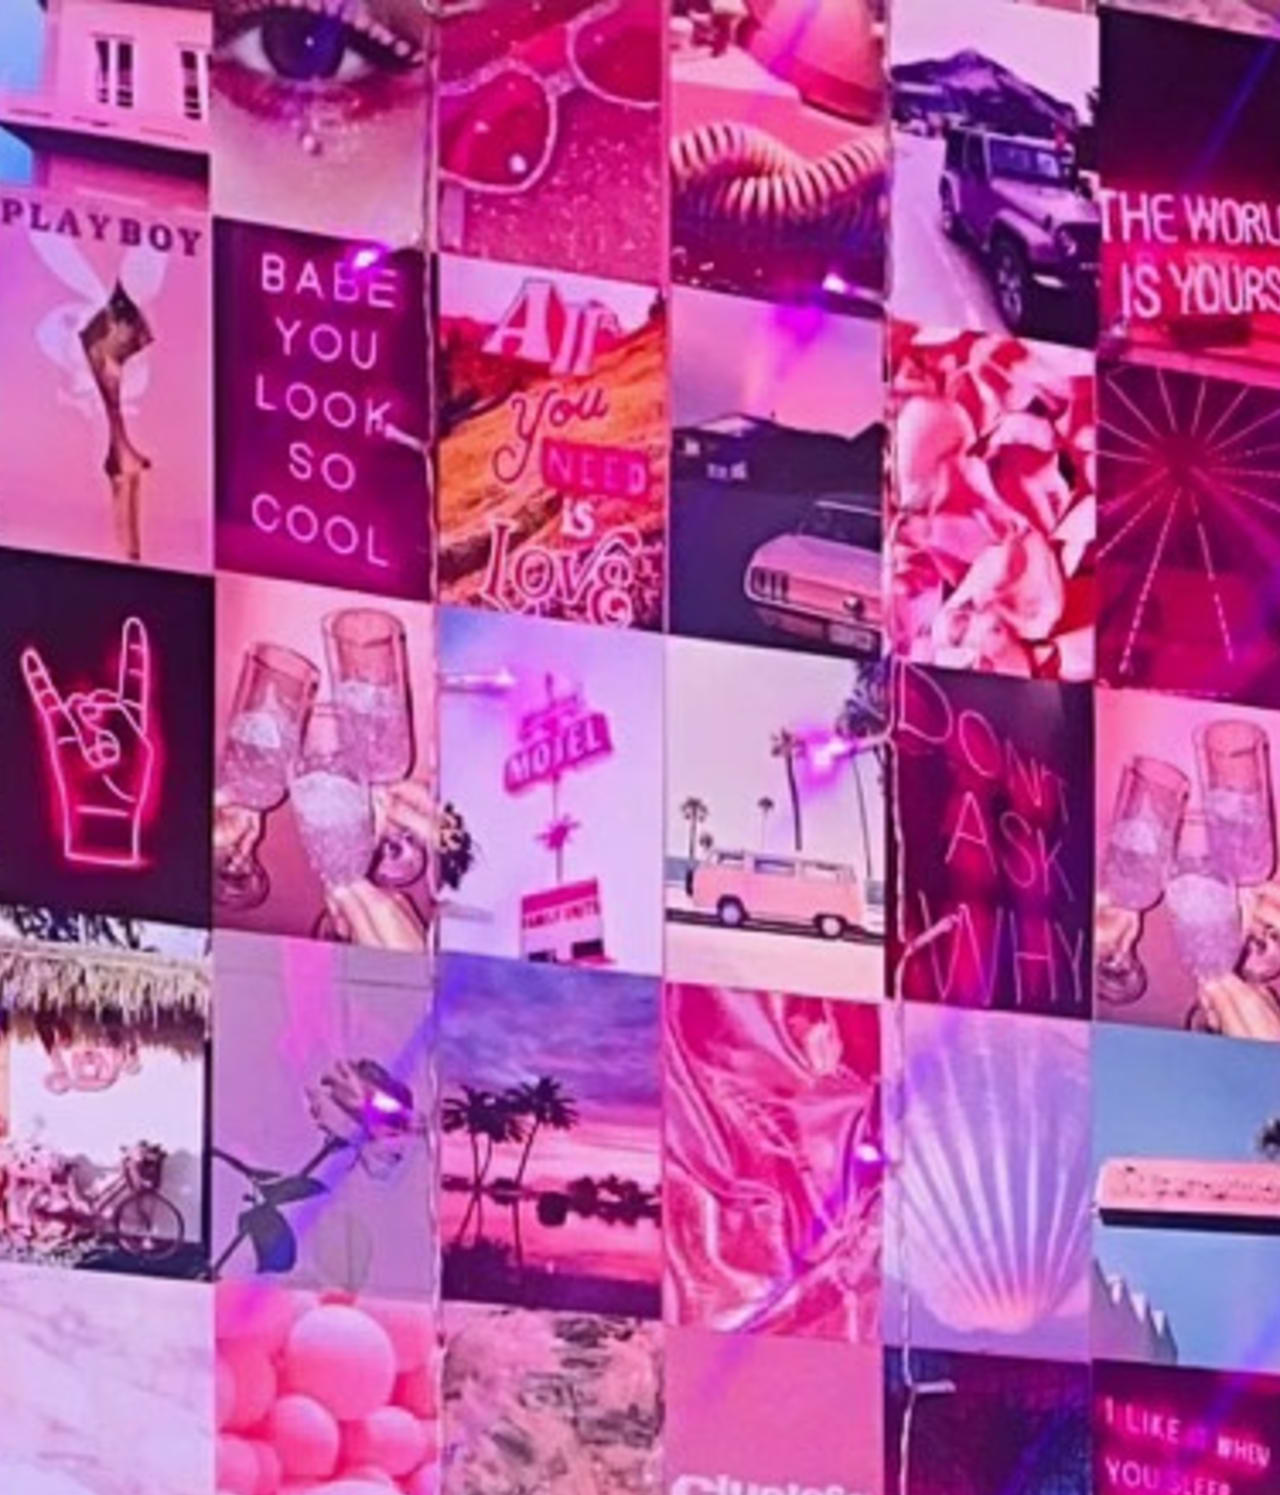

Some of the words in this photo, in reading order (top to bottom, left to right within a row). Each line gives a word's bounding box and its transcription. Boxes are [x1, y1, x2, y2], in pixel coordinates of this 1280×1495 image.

[0, 198, 203, 258] PLAYBOY
[1099, 189, 1176, 243] THE
[260, 251, 399, 309] BABE
[1121, 262, 1160, 317] IS
[275, 316, 379, 372] YOU
[255, 374, 388, 437] LOOK
[287, 441, 357, 491] SO
[250, 493, 389, 568] COOL
[945, 791, 1074, 903] ASK
[919, 889, 1084, 1006] WHY
[1105, 1456, 1160, 1491] YOU
